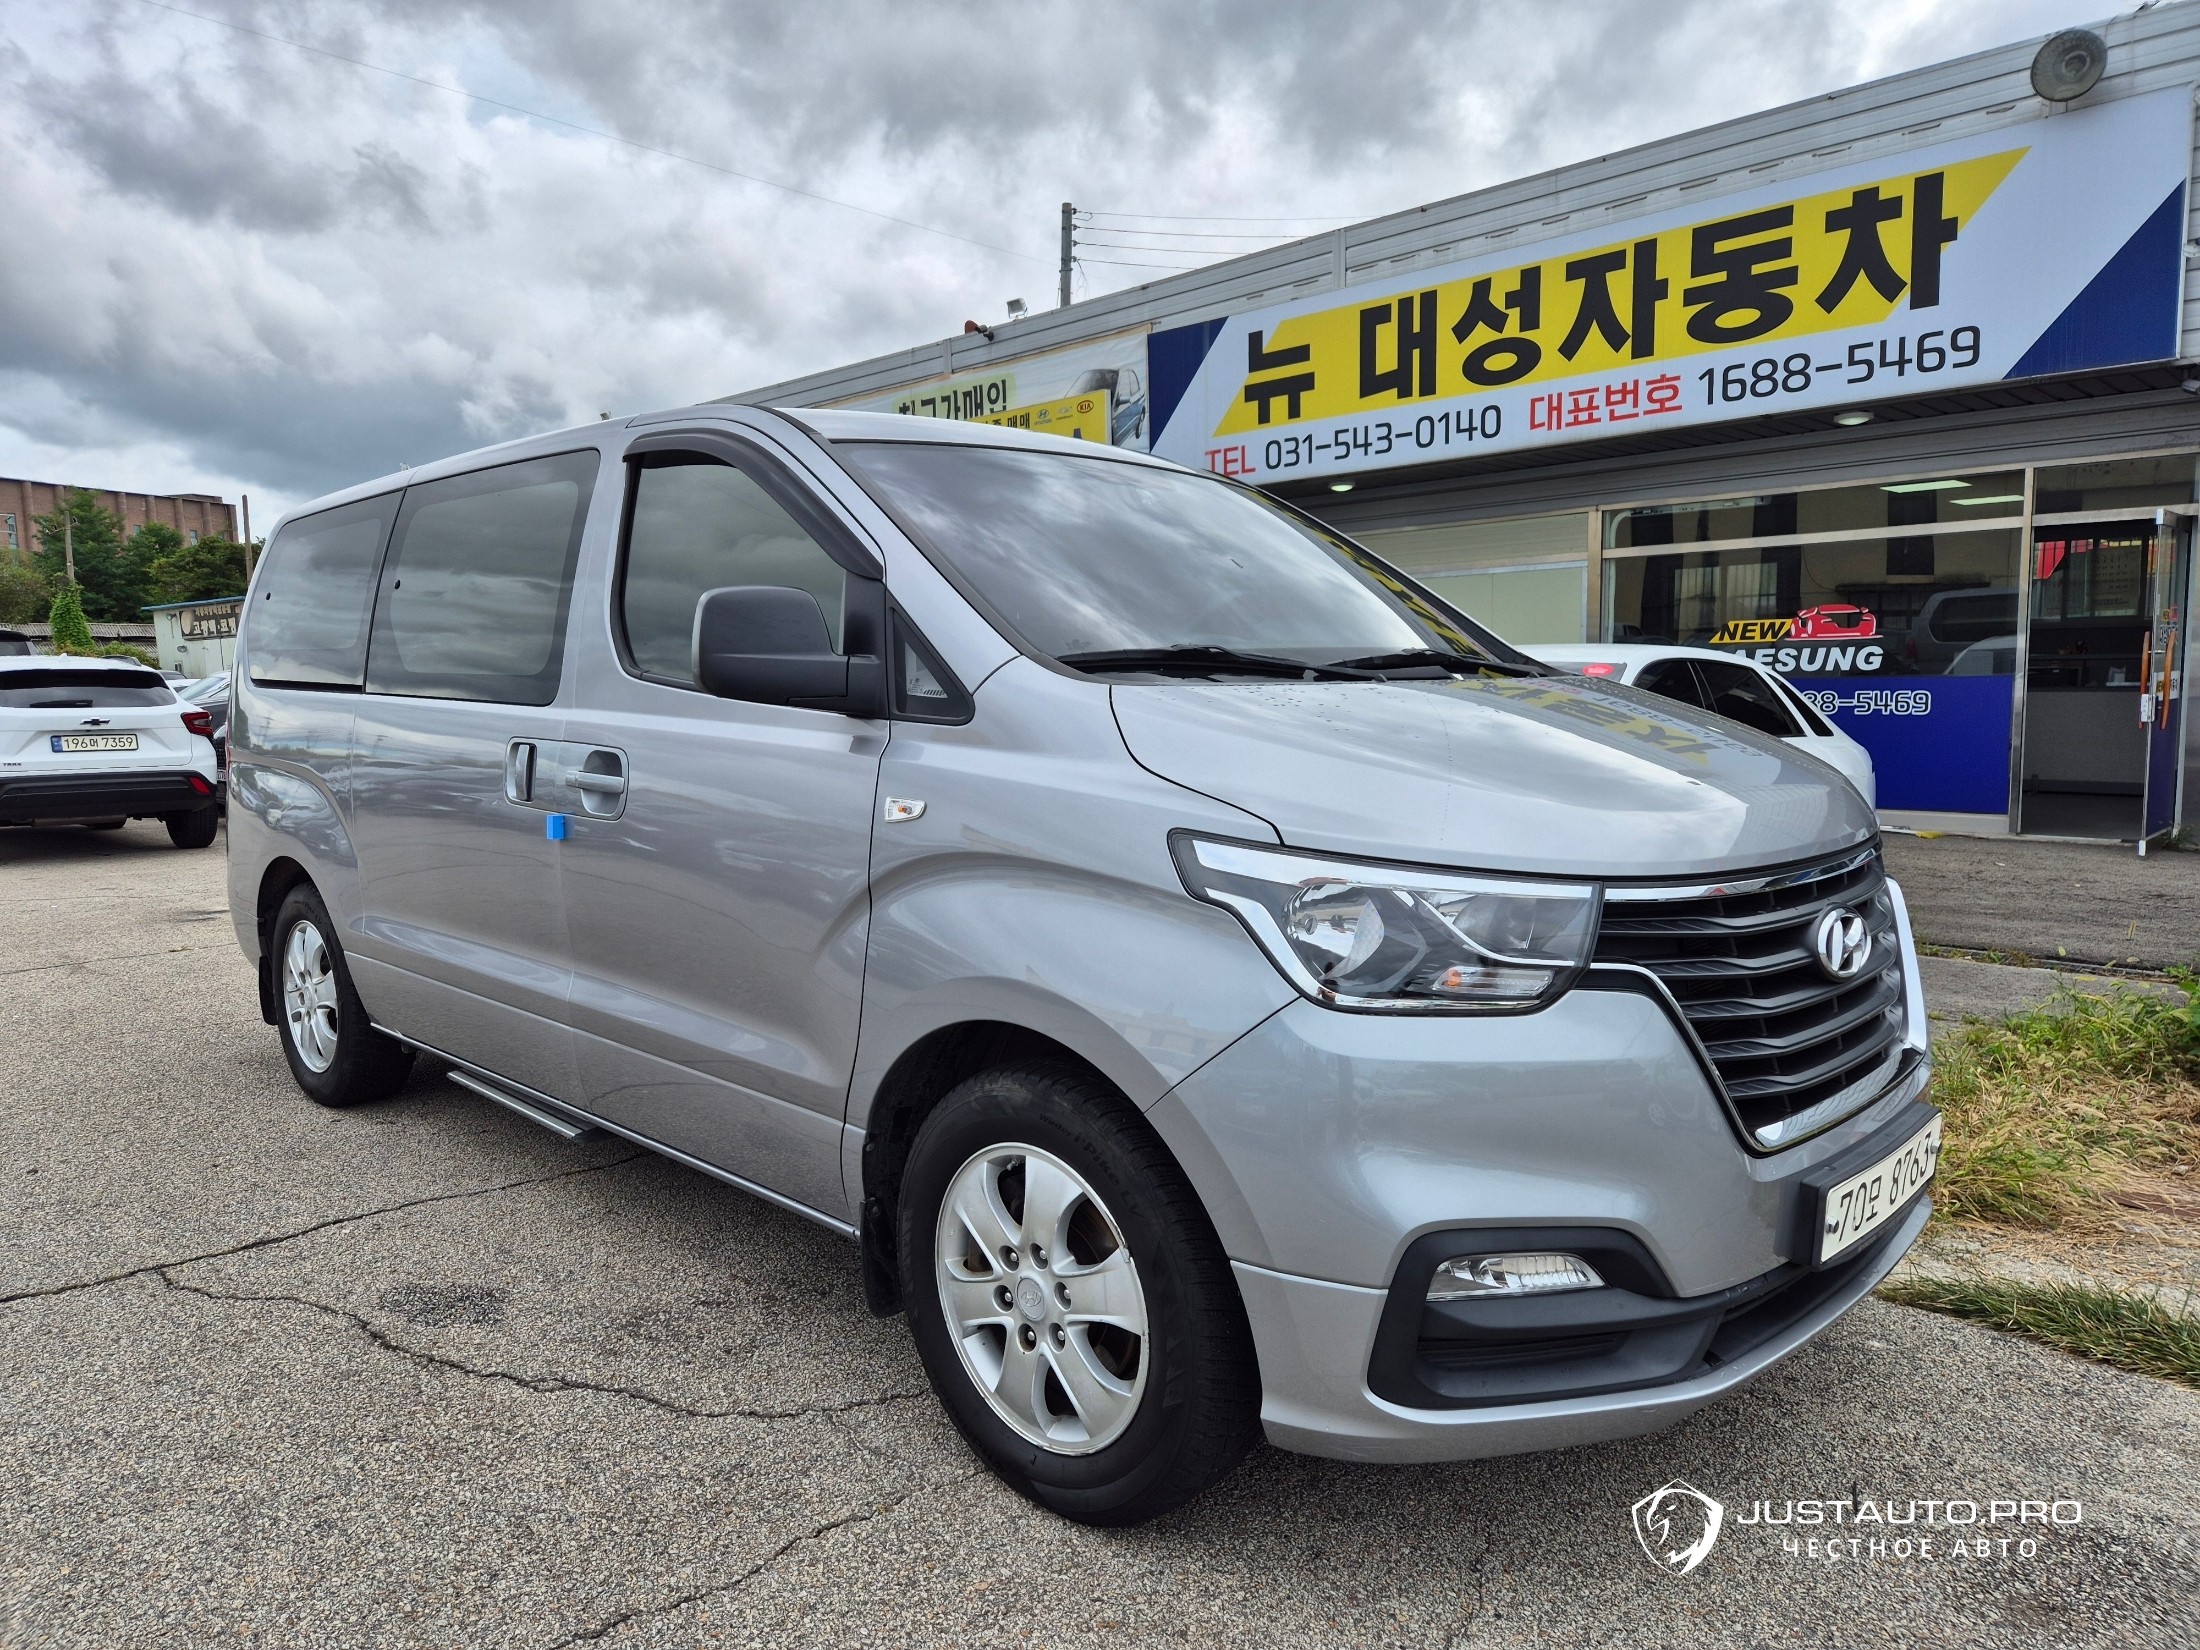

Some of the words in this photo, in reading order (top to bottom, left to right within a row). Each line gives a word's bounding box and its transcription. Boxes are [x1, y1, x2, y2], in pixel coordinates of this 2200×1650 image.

[1244, 329, 1315, 425] 뉴
[1359, 171, 1959, 400] 대성자동차
[1204, 445, 1257, 478] TEL
[1265, 404, 1502, 470] 031-543-0140
[1529, 372, 1683, 431] 대표번호
[1698, 325, 1981, 406] 1688-5469
[1718, 621, 1786, 641] NEW
[101, 736, 134, 748] 7359
[1838, 1175, 1883, 1242] 70모
[1889, 1130, 1932, 1206] 8763
